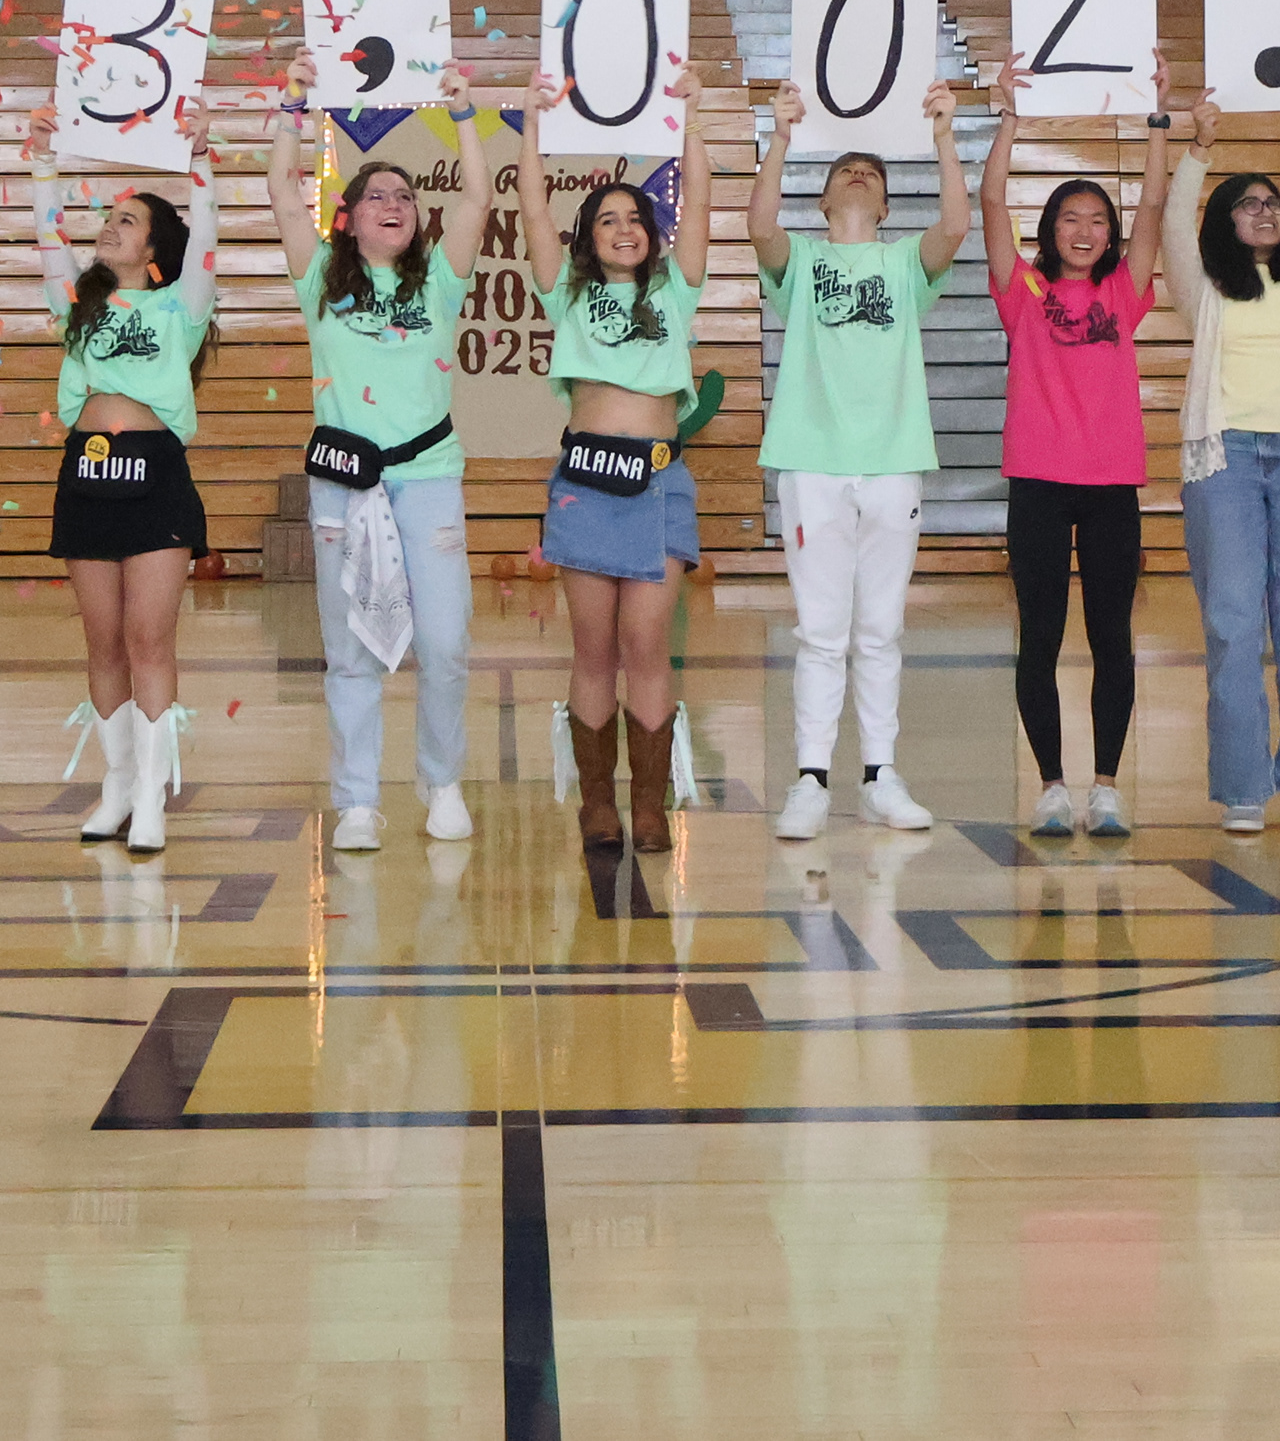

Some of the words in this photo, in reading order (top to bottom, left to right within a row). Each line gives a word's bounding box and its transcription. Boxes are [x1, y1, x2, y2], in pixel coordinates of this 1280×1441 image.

[457, 328, 555, 376] 025
[78, 455, 147, 482] ALIVIA
[569, 445, 645, 481] ALAINA
